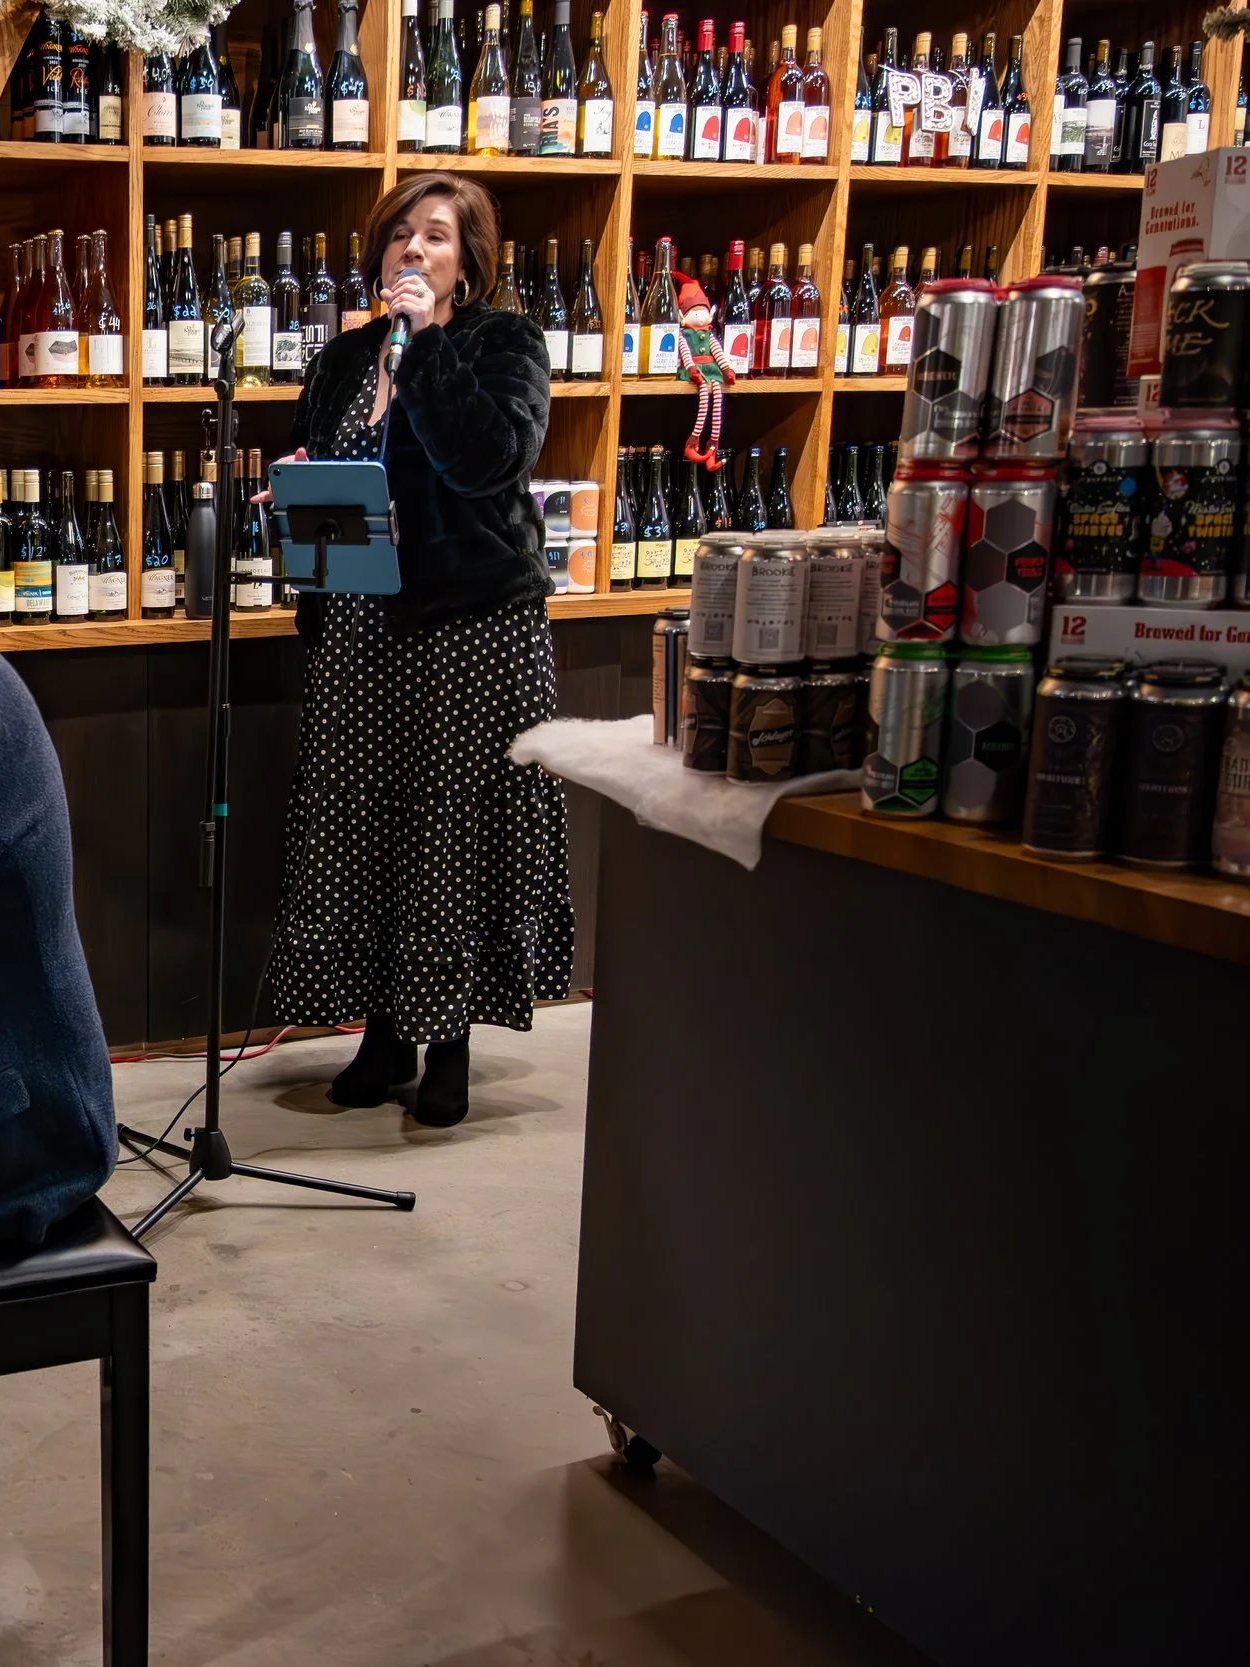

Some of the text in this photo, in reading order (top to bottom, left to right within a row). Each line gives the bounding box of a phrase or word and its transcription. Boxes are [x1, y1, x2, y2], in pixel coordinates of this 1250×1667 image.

[1225, 156, 1247, 176] 12
[1146, 168, 1158, 190] 12
[1150, 201, 1195, 219] Brewed for
[1145, 215, 1200, 236] Generations.
[174, 304, 197, 321] $22
[99, 315, 121, 332] $44
[1146, 383, 1160, 403] 12
[145, 553, 169, 567] $20
[147, 574, 174, 582] WAGNER
[1062, 615, 1087, 636] 12
[1134, 622, 1195, 641] Brewed
[1199, 624, 1222, 643] for
